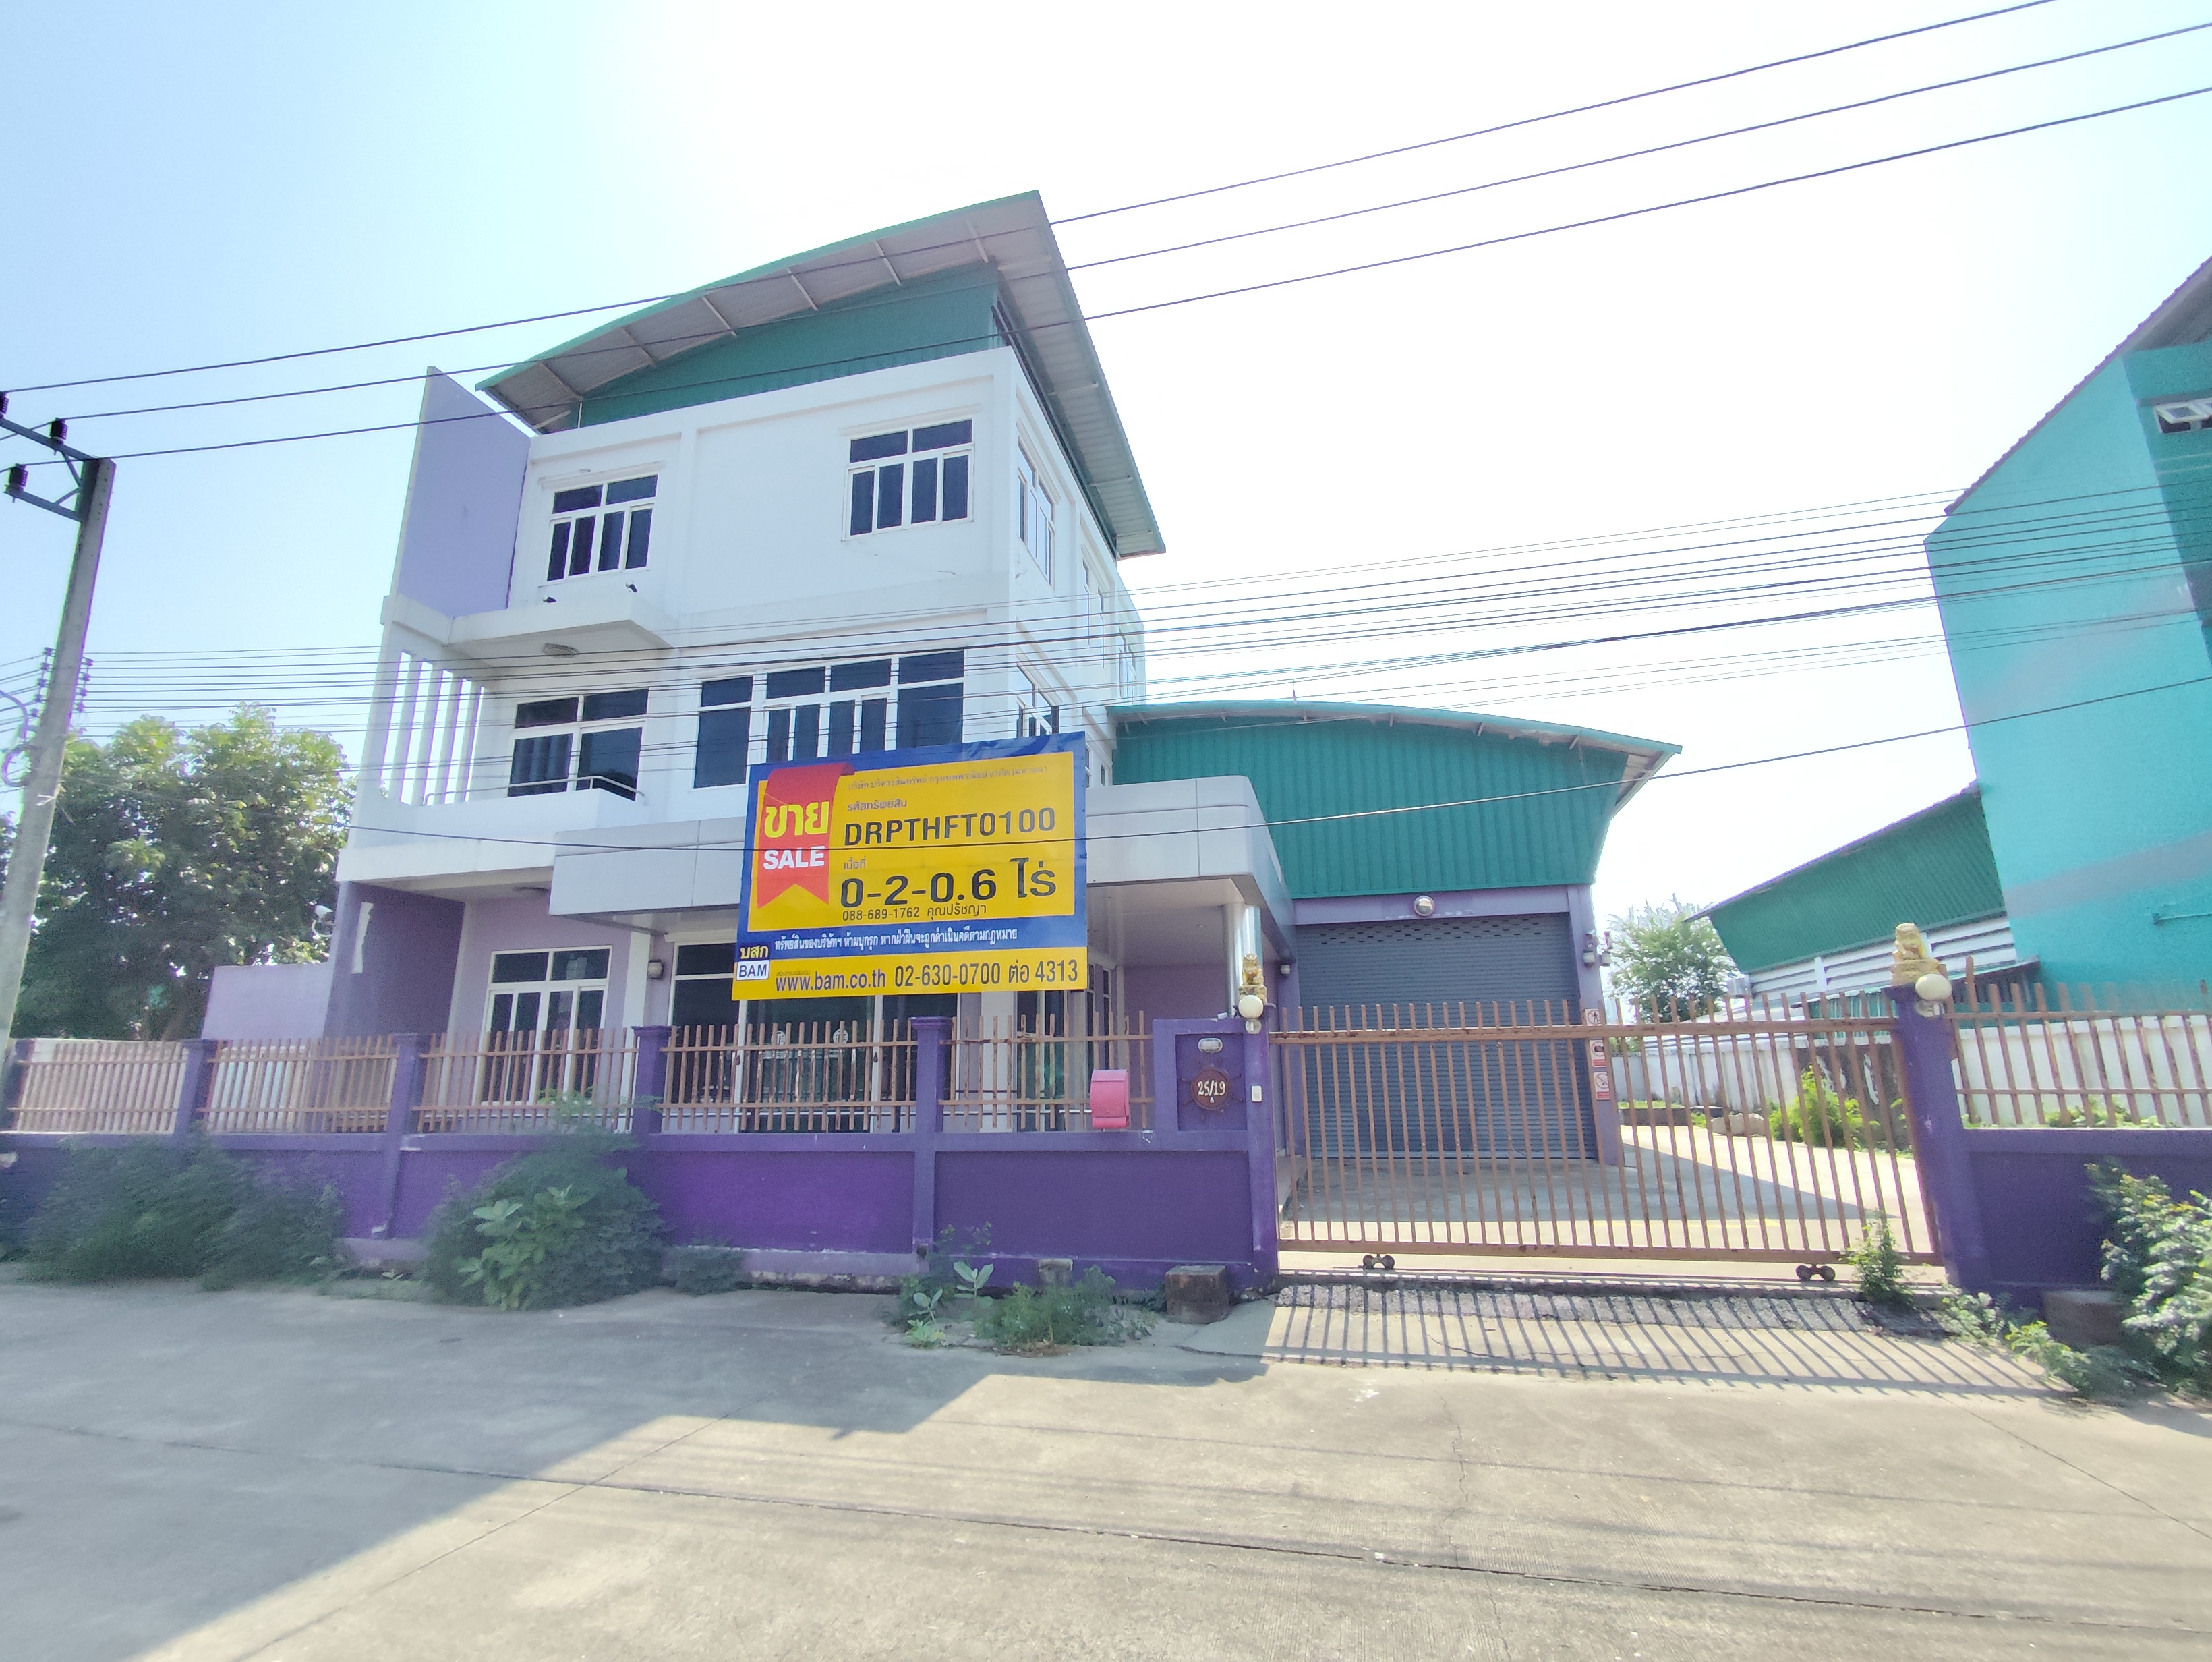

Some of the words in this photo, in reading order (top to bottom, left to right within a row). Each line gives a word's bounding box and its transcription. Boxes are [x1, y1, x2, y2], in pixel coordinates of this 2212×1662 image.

[847, 797, 908, 812] รหัสทรัพย์สิน
[764, 801, 830, 838] ขาย
[844, 807, 1055, 847] DRPTHFT0100
[763, 845, 825, 870] SALE
[844, 855, 867, 870] เนื้อที่
[1010, 857, 1057, 898] ไร่
[842, 906, 920, 921] 088-689-1762
[927, 902, 987, 921] คุณปรัชญา
[774, 932, 842, 950] ทรัพย์สินของบริษัทฯ
[844, 931, 879, 951] ห้ามบุกรุก
[739, 945, 769, 959] บสก
[738, 963, 767, 977] BAM
[775, 967, 886, 992] www.bam.co.th
[894, 962, 1001, 987] 02-630-0700
[1008, 959, 1030, 984] ต่อ
[1035, 958, 1078, 983] 4313
[1197, 1079, 1226, 1097] 25/19
